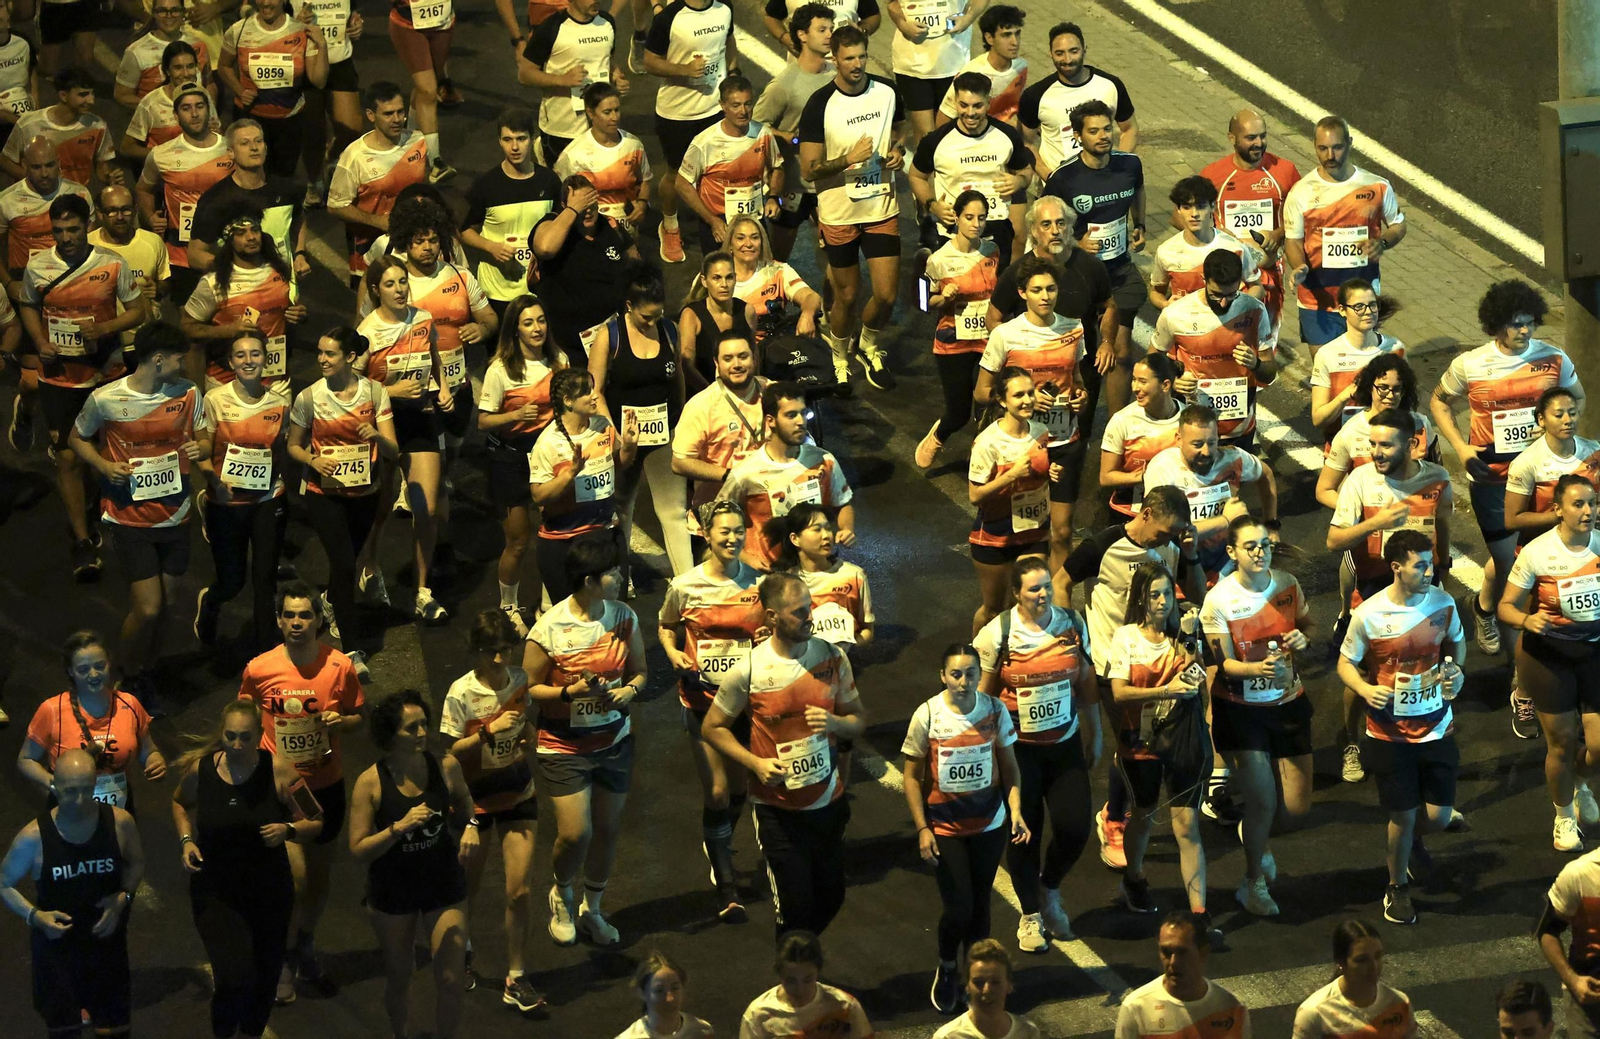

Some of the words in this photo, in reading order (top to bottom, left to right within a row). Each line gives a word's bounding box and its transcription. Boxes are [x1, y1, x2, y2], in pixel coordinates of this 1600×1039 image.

[419, 5, 443, 19] 2167
[694, 25, 725, 37] HITACHI
[578, 36, 608, 44] HITACHI
[257, 67, 284, 79] 9859
[846, 111, 881, 126] HITACHI
[960, 154, 997, 164] HITACHI
[855, 174, 880, 188] 2347
[1094, 194, 1118, 204] GREEN
[1234, 213, 1263, 227] 2930
[964, 317, 985, 329] 898
[54, 332, 82, 345] 1179
[1208, 395, 1237, 408] 3898
[1504, 425, 1534, 441] 3987
[227, 463, 267, 478] 22762
[331, 461, 364, 476] 2745
[136, 469, 175, 488] 20300
[584, 472, 610, 490] 3082
[704, 657, 740, 672] 2056
[1400, 687, 1436, 704] 23770
[1029, 702, 1061, 719] 6067
[281, 732, 322, 749] 15932
[792, 753, 824, 774] 6046
[949, 763, 983, 779] 6045
[52, 858, 113, 880] PILATES
